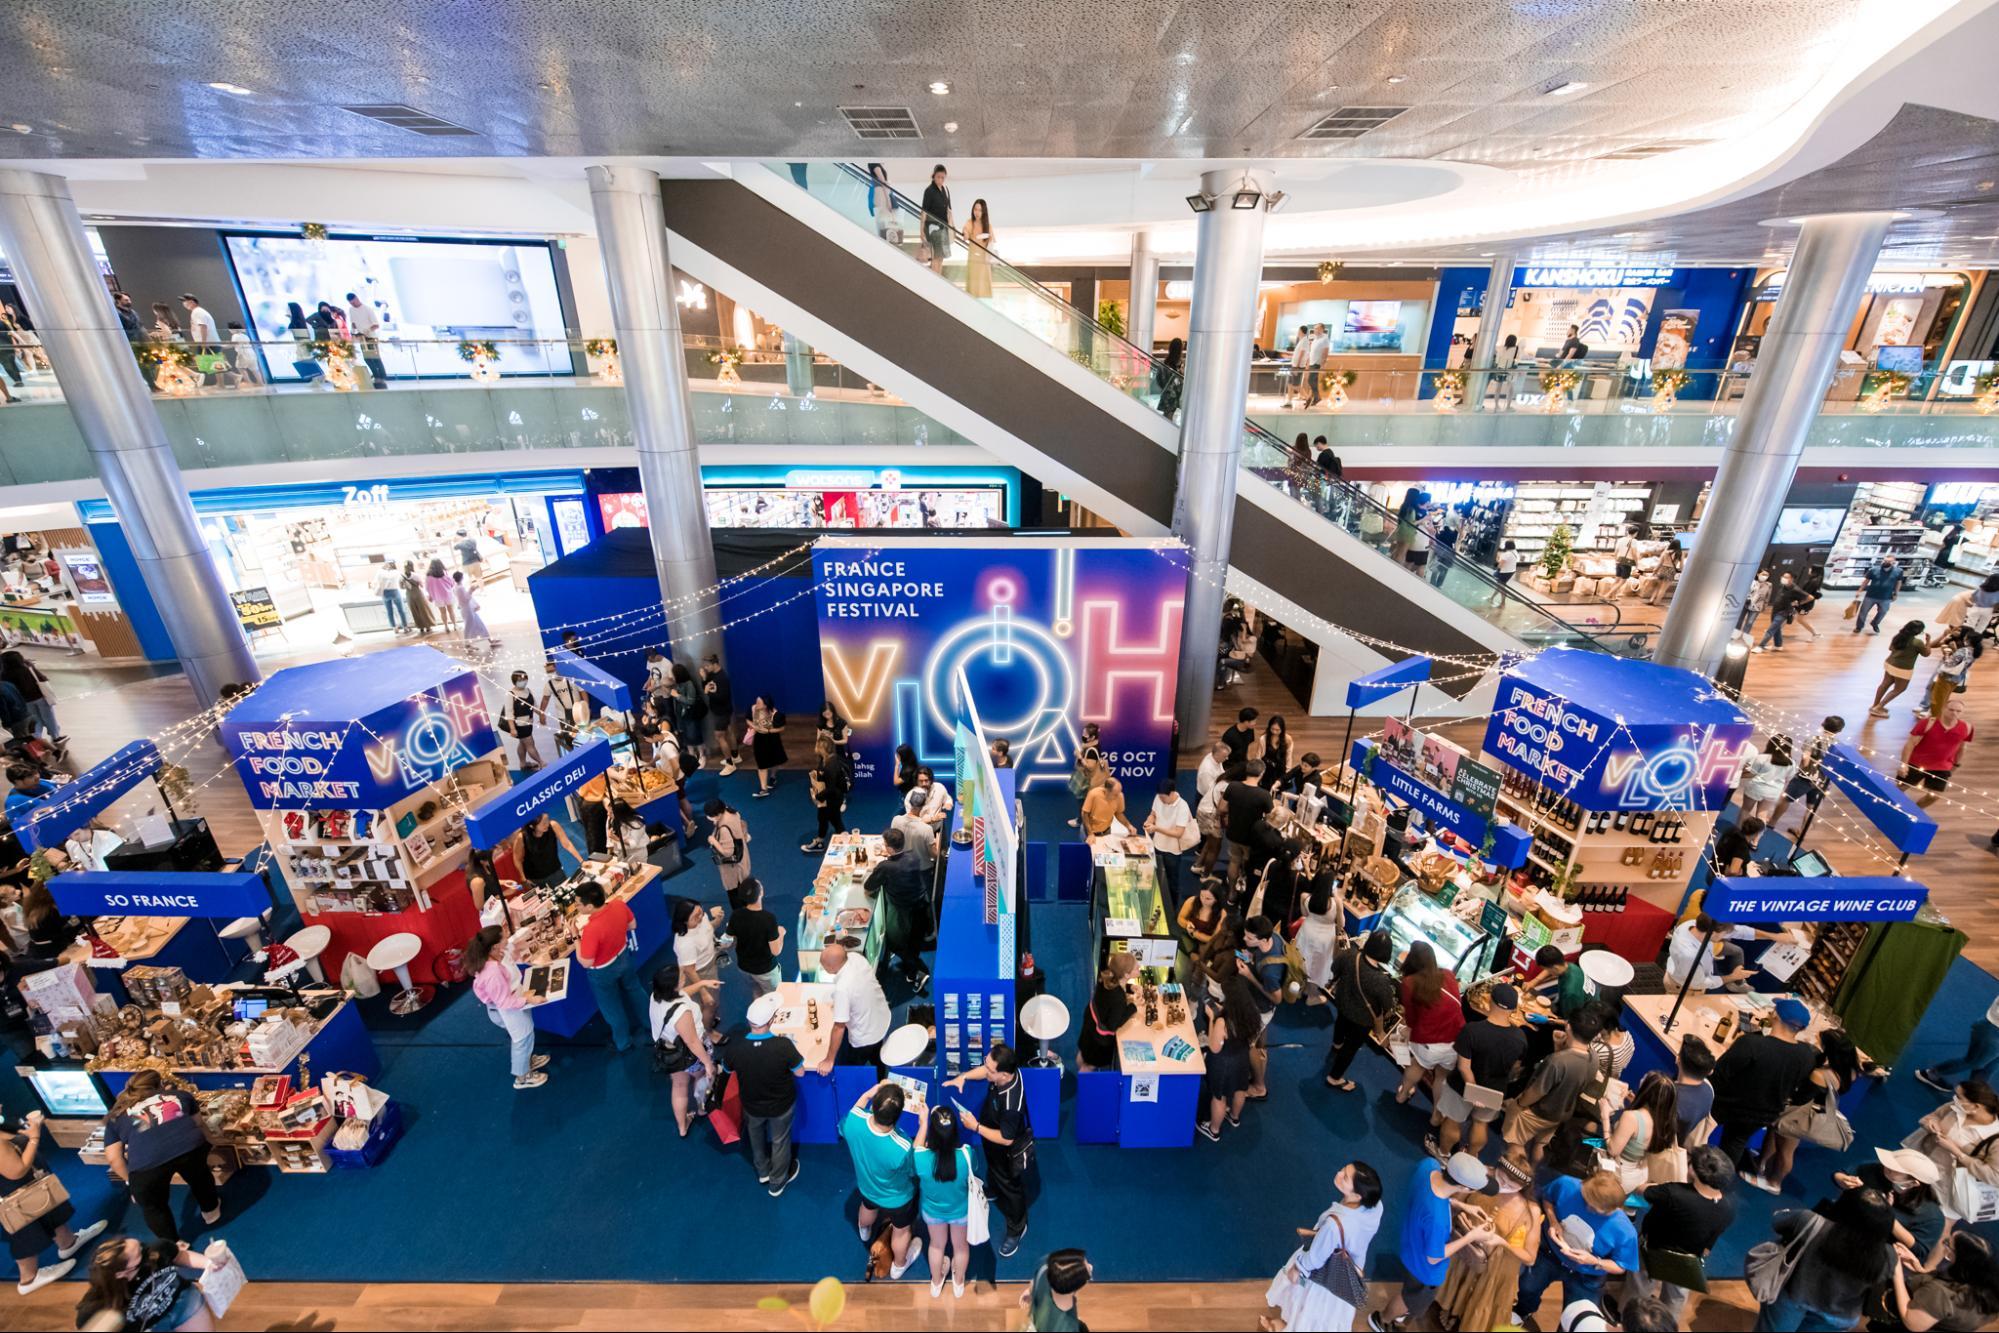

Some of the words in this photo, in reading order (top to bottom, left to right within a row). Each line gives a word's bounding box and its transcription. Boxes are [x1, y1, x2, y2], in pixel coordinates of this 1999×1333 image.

[1524, 268, 1625, 286] KANSHOKU
[342, 484, 389, 506] Zoff
[823, 562, 906, 577] FRANCE
[825, 583, 944, 597] SINGAPORE
[827, 603, 920, 617] FESTIVAL
[1510, 686, 1599, 742] FRENCH
[1503, 710, 1564, 751] FOOD
[239, 732, 343, 750] FRENCH
[250, 757, 323, 775] FOOD
[1122, 752, 1156, 762] OCT
[1497, 732, 1585, 788] MARKET
[1121, 767, 1155, 777] NOV
[259, 782, 360, 799] MARKET
[516, 781, 563, 817] CLASSIC
[564, 765, 586, 786] DELI
[1392, 775, 1420, 799] LITTLE
[1422, 794, 1460, 824] FARMS
[105, 895, 129, 907] SO
[132, 895, 199, 907] FRANCE
[1728, 900, 1757, 912] THE
[1761, 900, 1830, 912] VINTAGE
[1833, 900, 1874, 912] WINE
[1876, 900, 1917, 911] CLUB
